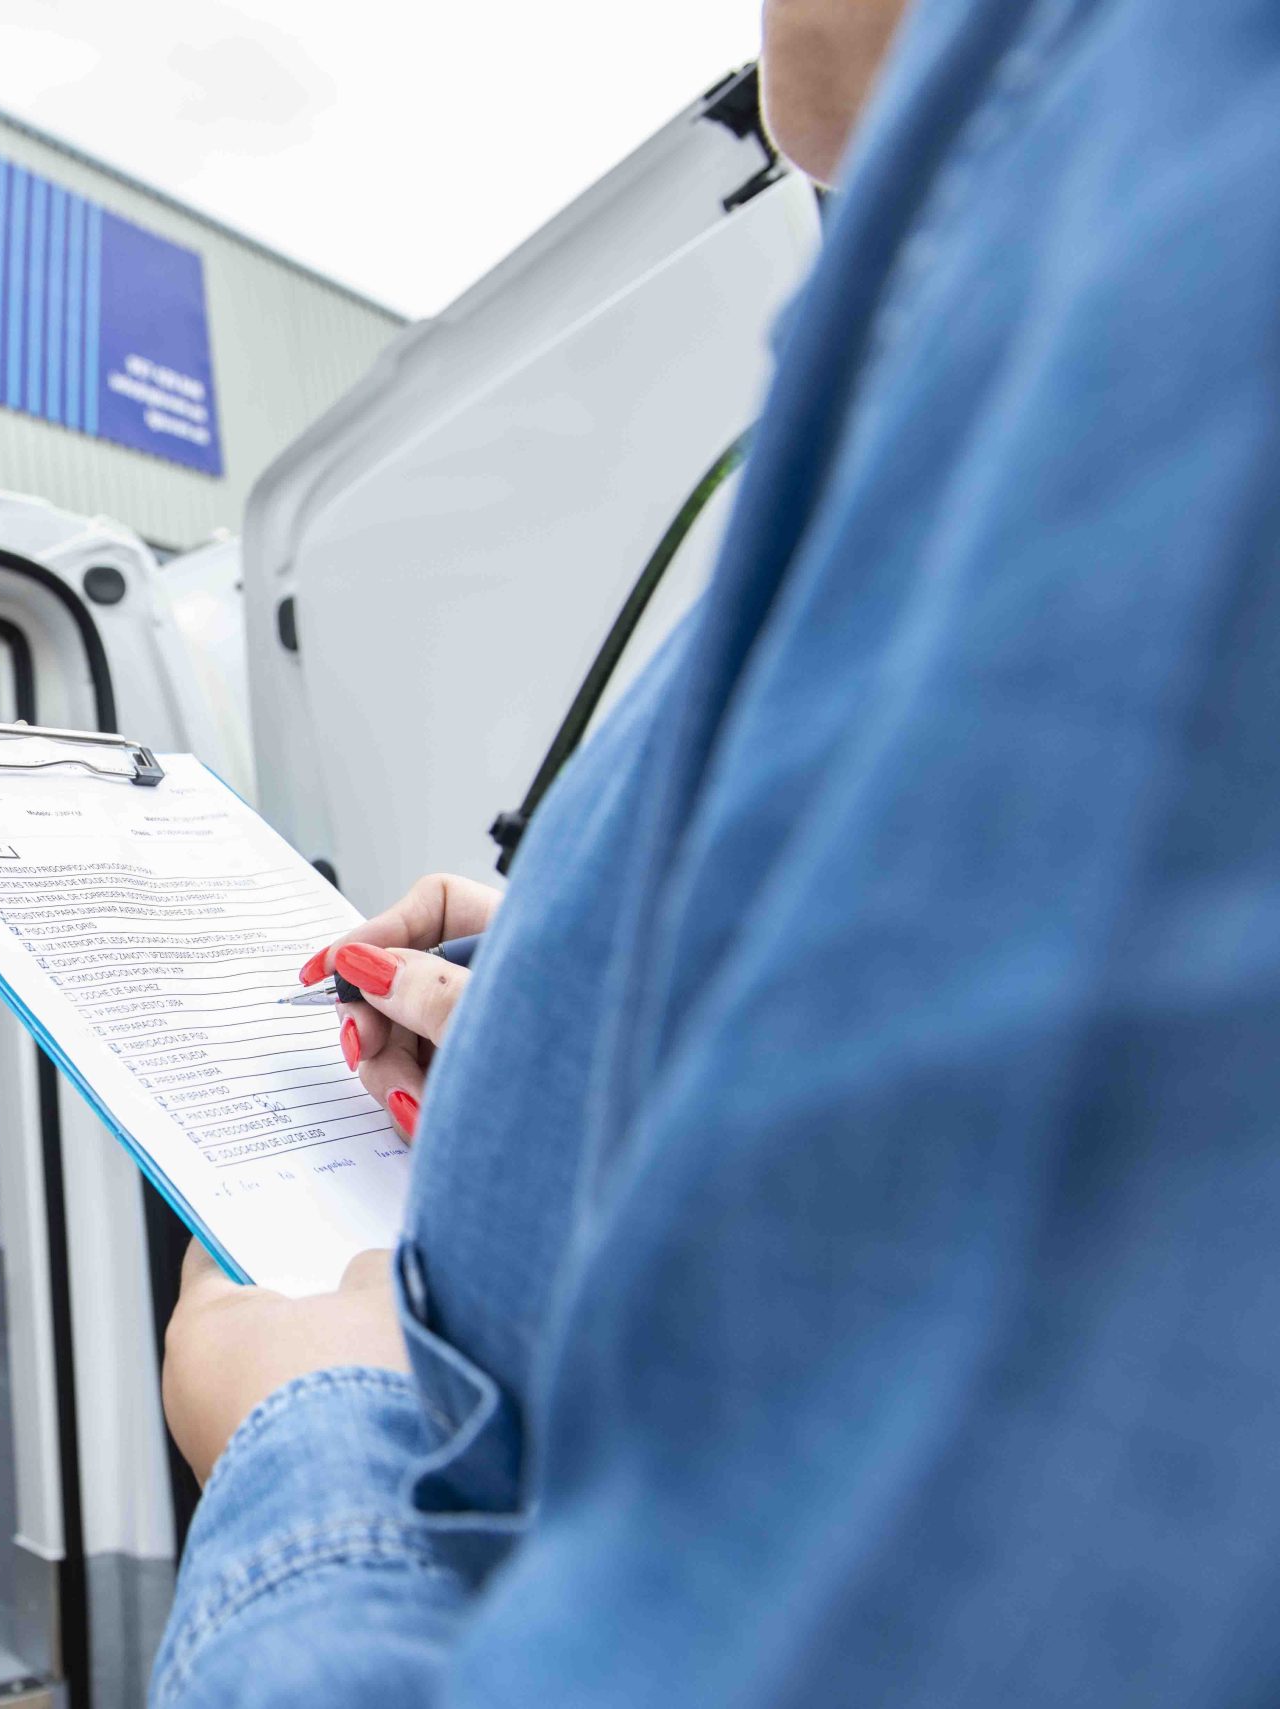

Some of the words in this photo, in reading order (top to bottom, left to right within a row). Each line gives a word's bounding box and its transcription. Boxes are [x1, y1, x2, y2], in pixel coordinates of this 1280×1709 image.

[66, 879, 79, 887] DE
[31, 894, 66, 904] LATERAL
[55, 909, 76, 918] PARA
[24, 926, 45, 935] PISO
[46, 924, 75, 934] COLOR
[76, 922, 98, 931] GRIS
[39, 942, 55, 951] LUZ
[55, 938, 96, 950] INTERIOR
[96, 937, 107, 946] DE
[51, 956, 85, 968] EQUIPO
[86, 954, 98, 963] DE
[99, 951, 119, 961] FRIO
[80, 988, 110, 1000] COCHE
[110, 986, 125, 996] DE
[124, 983, 162, 994] SANCHEZ
[108, 1018, 168, 1032] PREPARACION
[123, 1035, 178, 1050] FABRICACION
[179, 1034, 190, 1042] DE
[190, 1032, 209, 1041] PISO
[138, 1056, 169, 1067] PASOS
[169, 1055, 181, 1064] DE
[181, 1050, 209, 1062] RUEDA
[154, 1070, 198, 1084] PREPARAR
[198, 1067, 223, 1079] FIBRA
[169, 1090, 210, 1104] ENFIBRAR
[210, 1085, 231, 1096] PISO
[186, 1107, 221, 1121] PINTADO
[221, 1106, 233, 1116] DE
[233, 1101, 253, 1112] PISO
[201, 1120, 263, 1139] PROTECCIONES
[261, 1117, 275, 1127] DE
[273, 1114, 293, 1124] PISO
[219, 1140, 270, 1159] COLOCACION
[269, 1137, 282, 1148] DE
[281, 1133, 297, 1145] LUZ
[296, 1132, 309, 1143] DE
[308, 1128, 327, 1139] LEDS
